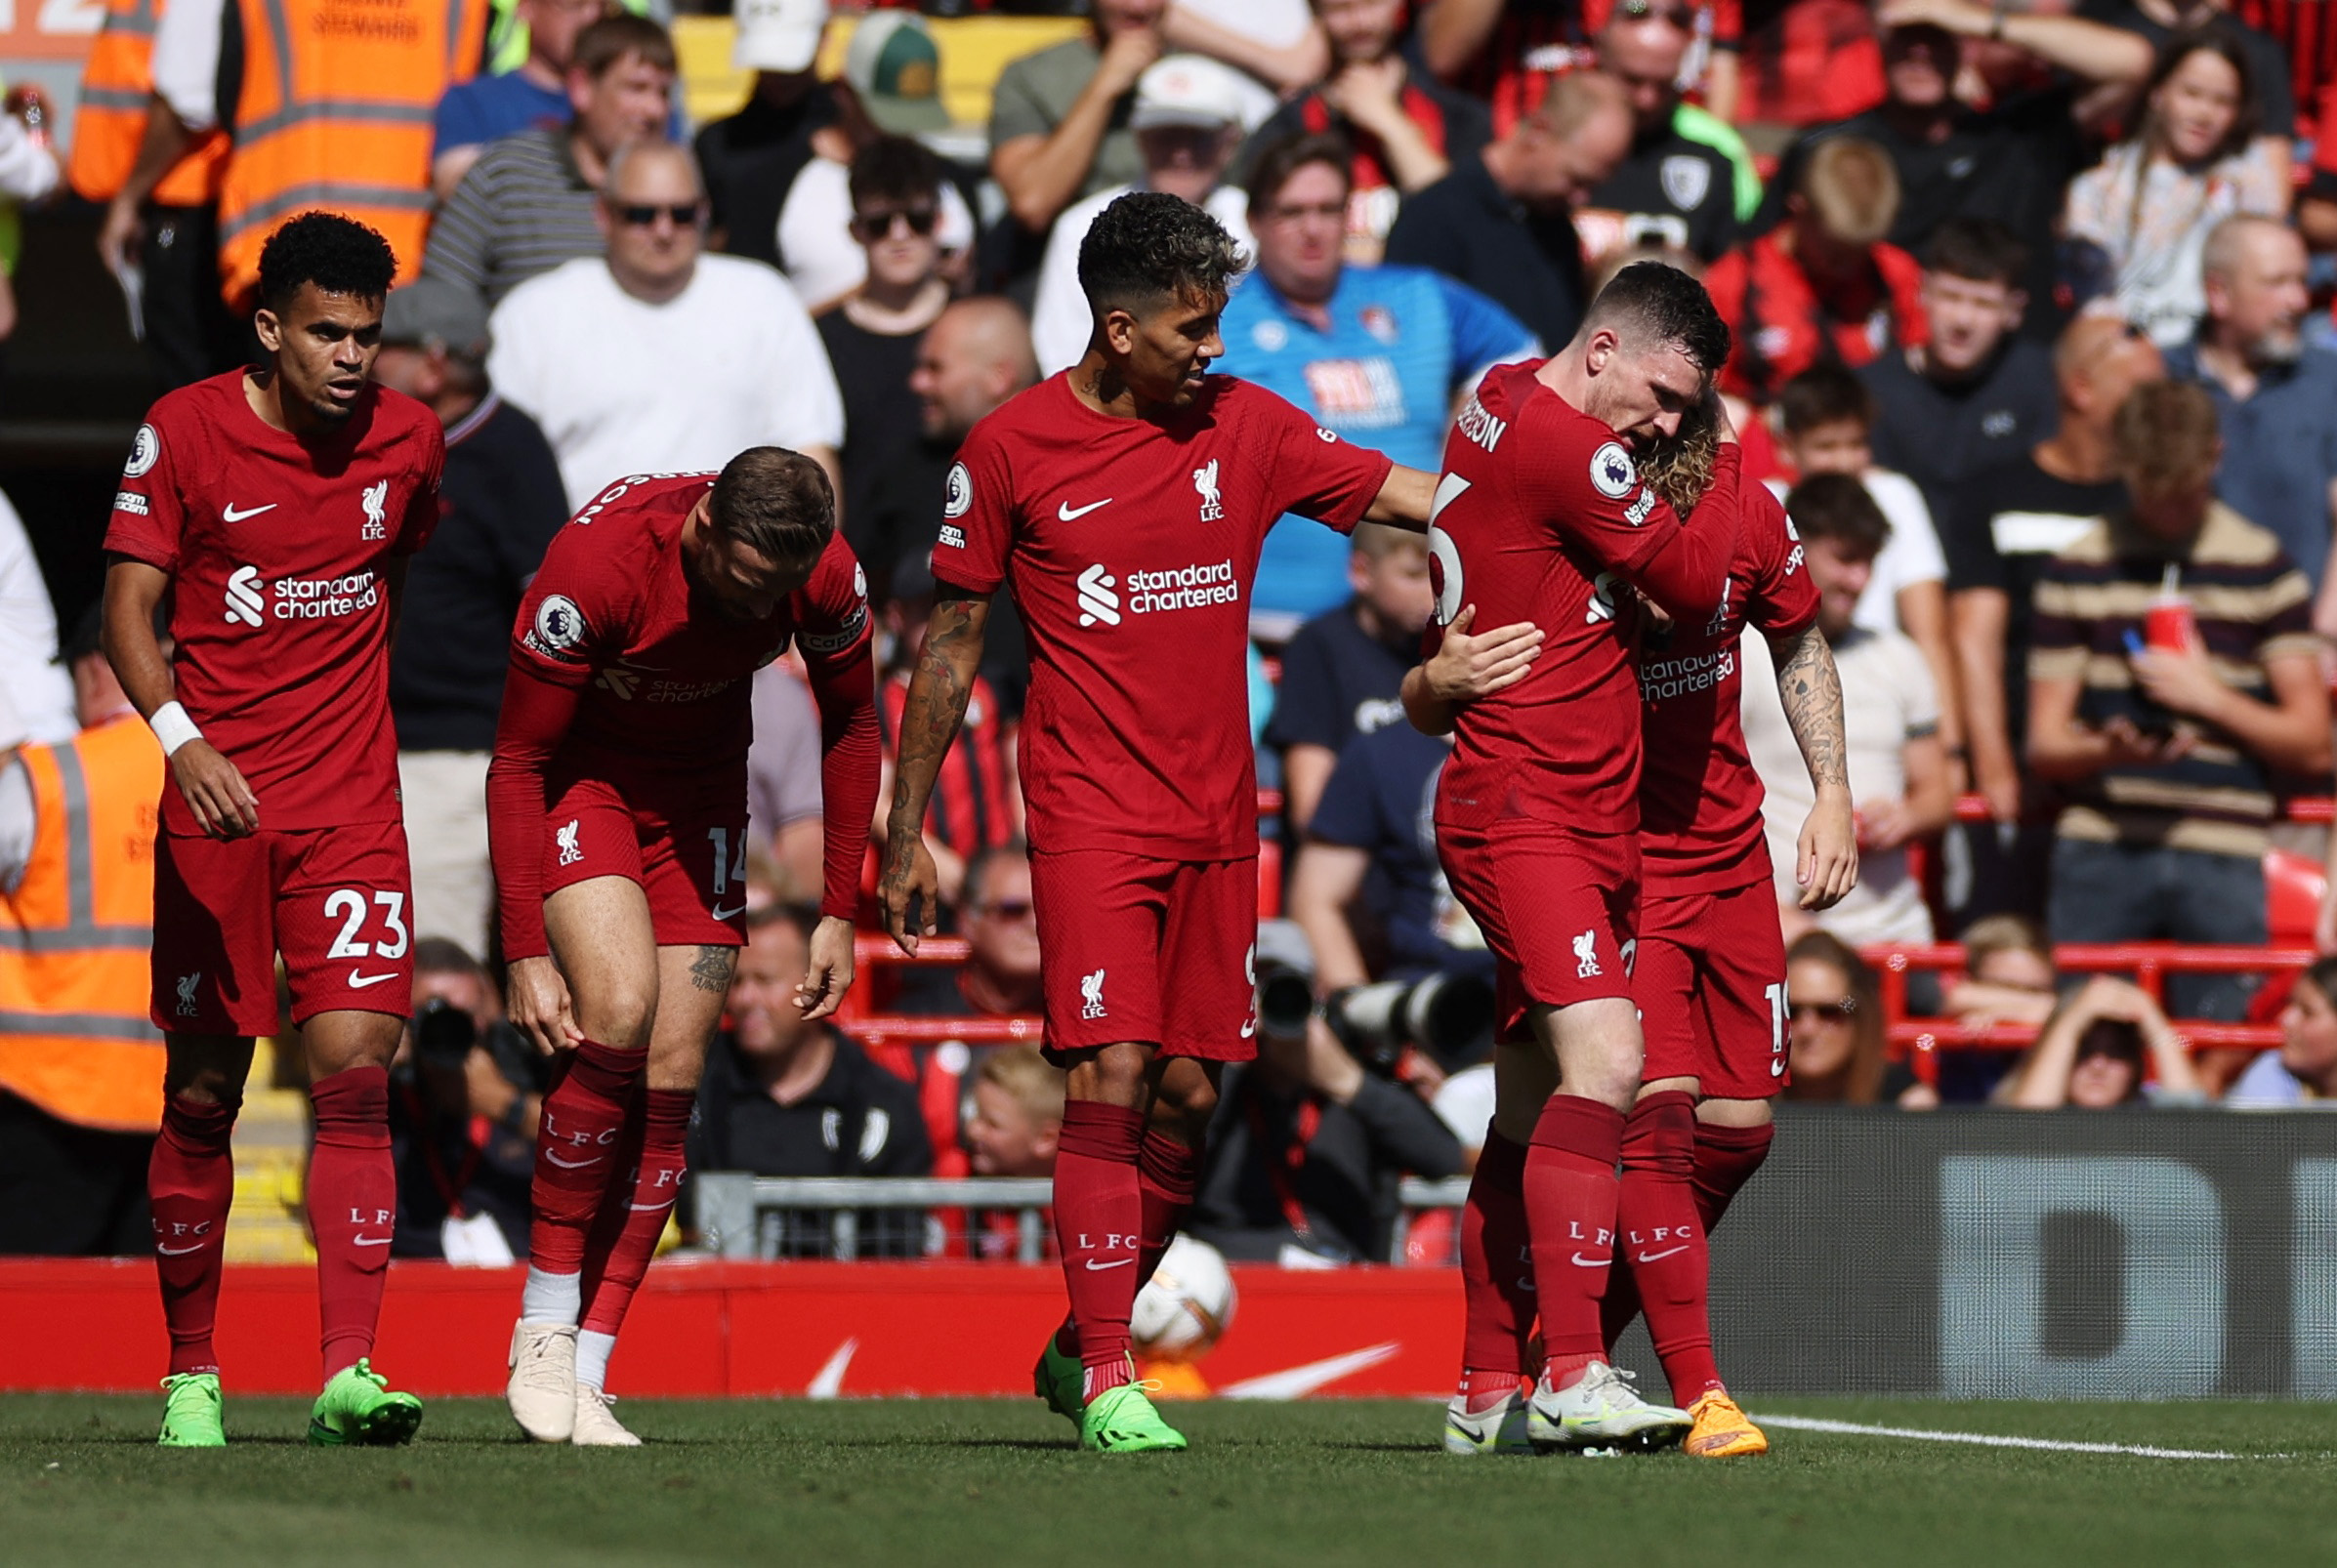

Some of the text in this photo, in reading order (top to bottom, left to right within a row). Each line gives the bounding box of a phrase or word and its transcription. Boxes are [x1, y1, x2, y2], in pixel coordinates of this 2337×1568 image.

[1127, 557, 1232, 593] standard
[1129, 579, 1239, 614] chartered
[1639, 645, 1729, 681] tandard
[323, 887, 408, 960] 23
